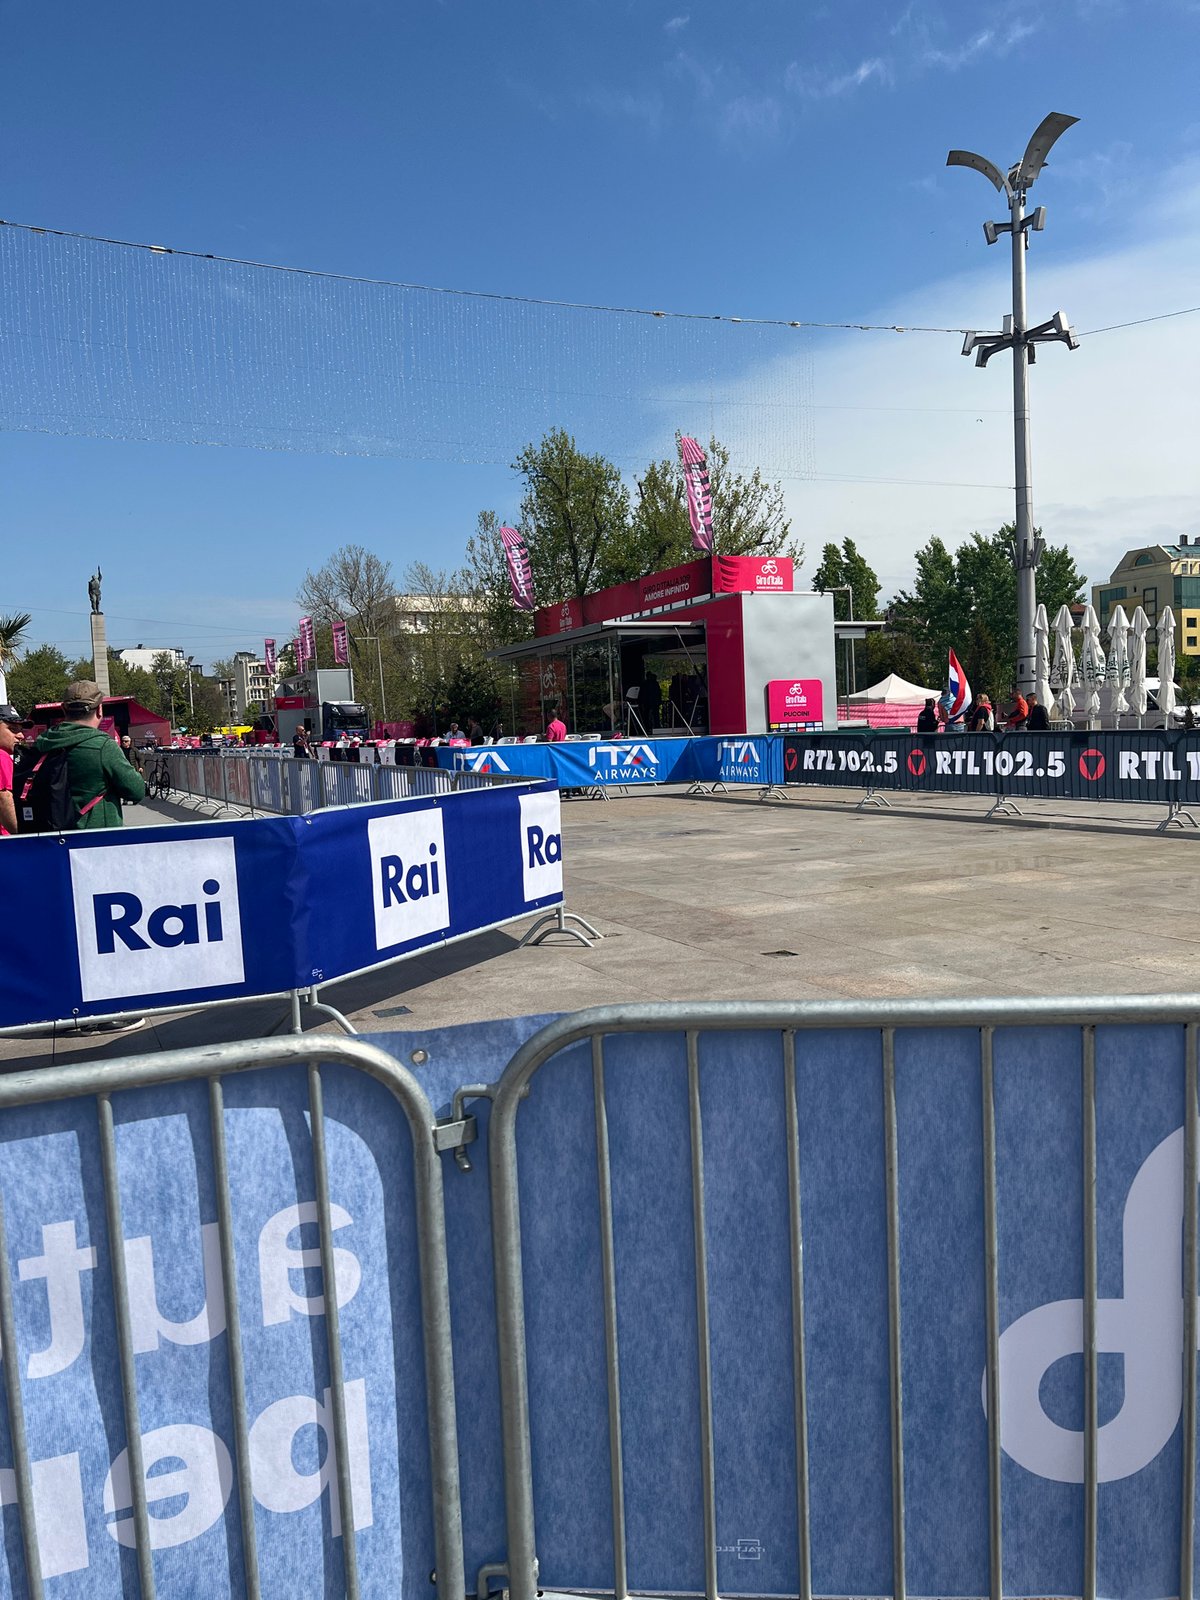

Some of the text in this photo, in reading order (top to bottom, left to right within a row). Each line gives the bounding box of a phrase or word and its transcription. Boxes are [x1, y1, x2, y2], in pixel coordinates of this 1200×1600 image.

[645, 583, 690, 602] AMORE INFINITO
[588, 745, 660, 767] ITA
[717, 742, 760, 763] ITA
[803, 750, 898, 773] RTL 102.5
[594, 767, 656, 780] AIRWAYS
[720, 766, 759, 778] AIRWAYS
[936, 751, 1066, 778] RTL 102.5
[1119, 751, 1181, 780] RTL
[381, 842, 440, 909] Rai
[93, 879, 223, 955] Rai
